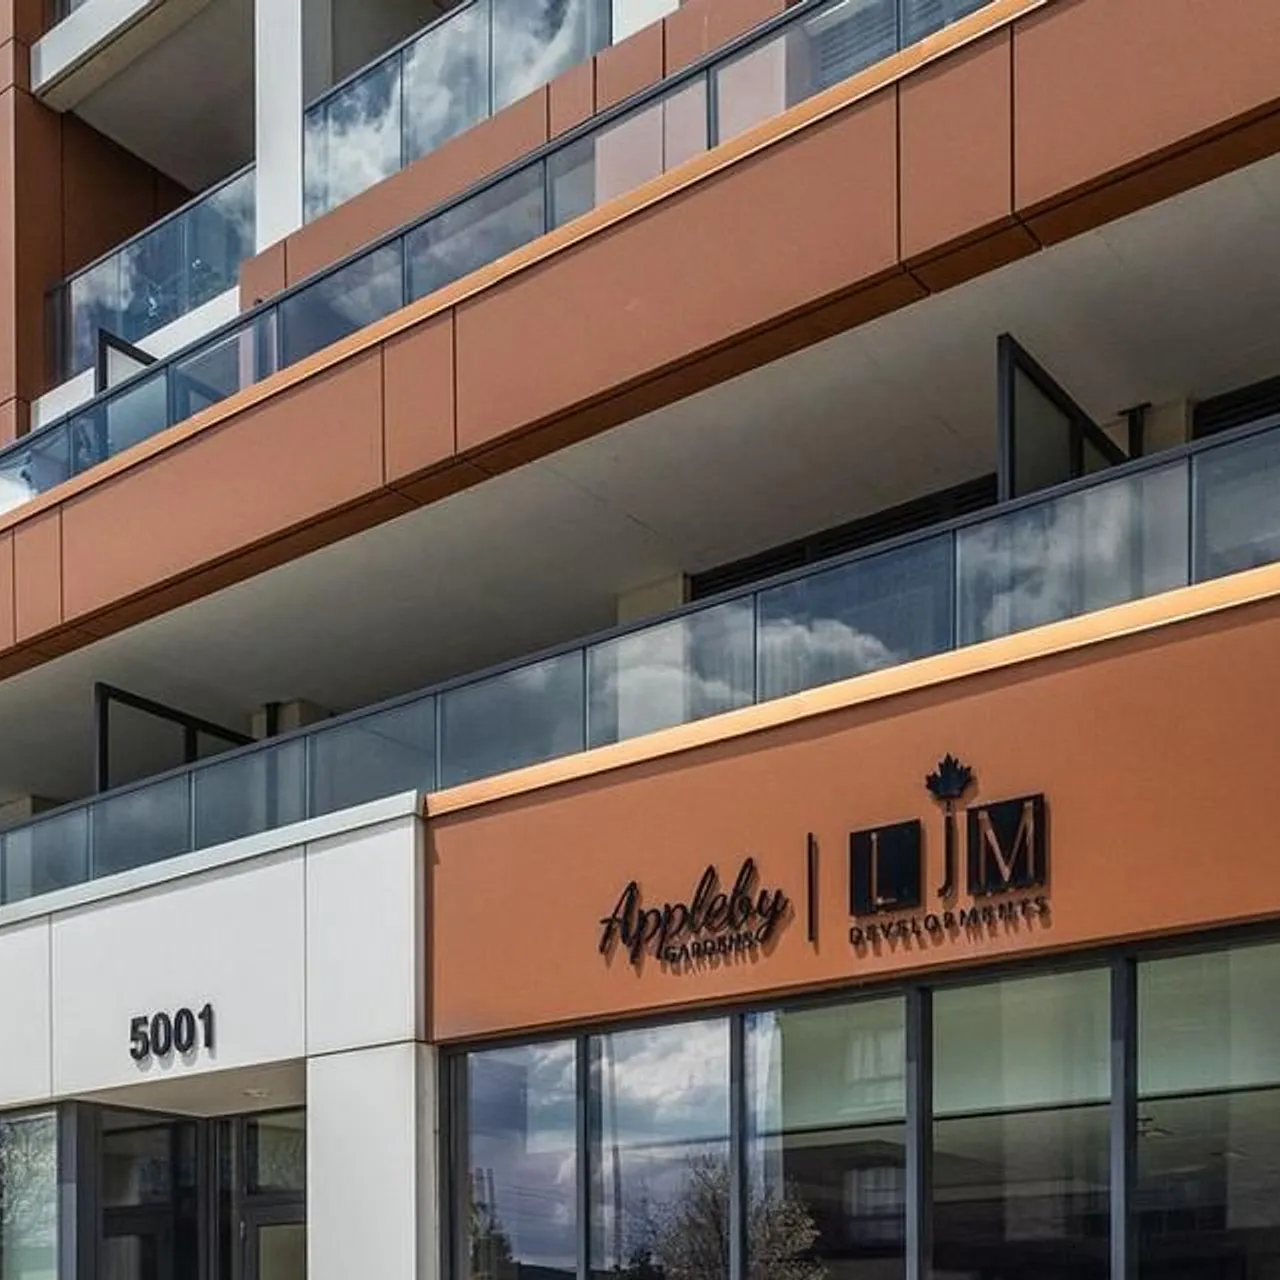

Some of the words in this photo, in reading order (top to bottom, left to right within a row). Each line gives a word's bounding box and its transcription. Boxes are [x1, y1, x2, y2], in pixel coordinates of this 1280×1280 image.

[598, 857, 786, 965] Appleby
[849, 896, 1047, 944] DEVELOPMENTS
[129, 1003, 214, 1060] 5001
